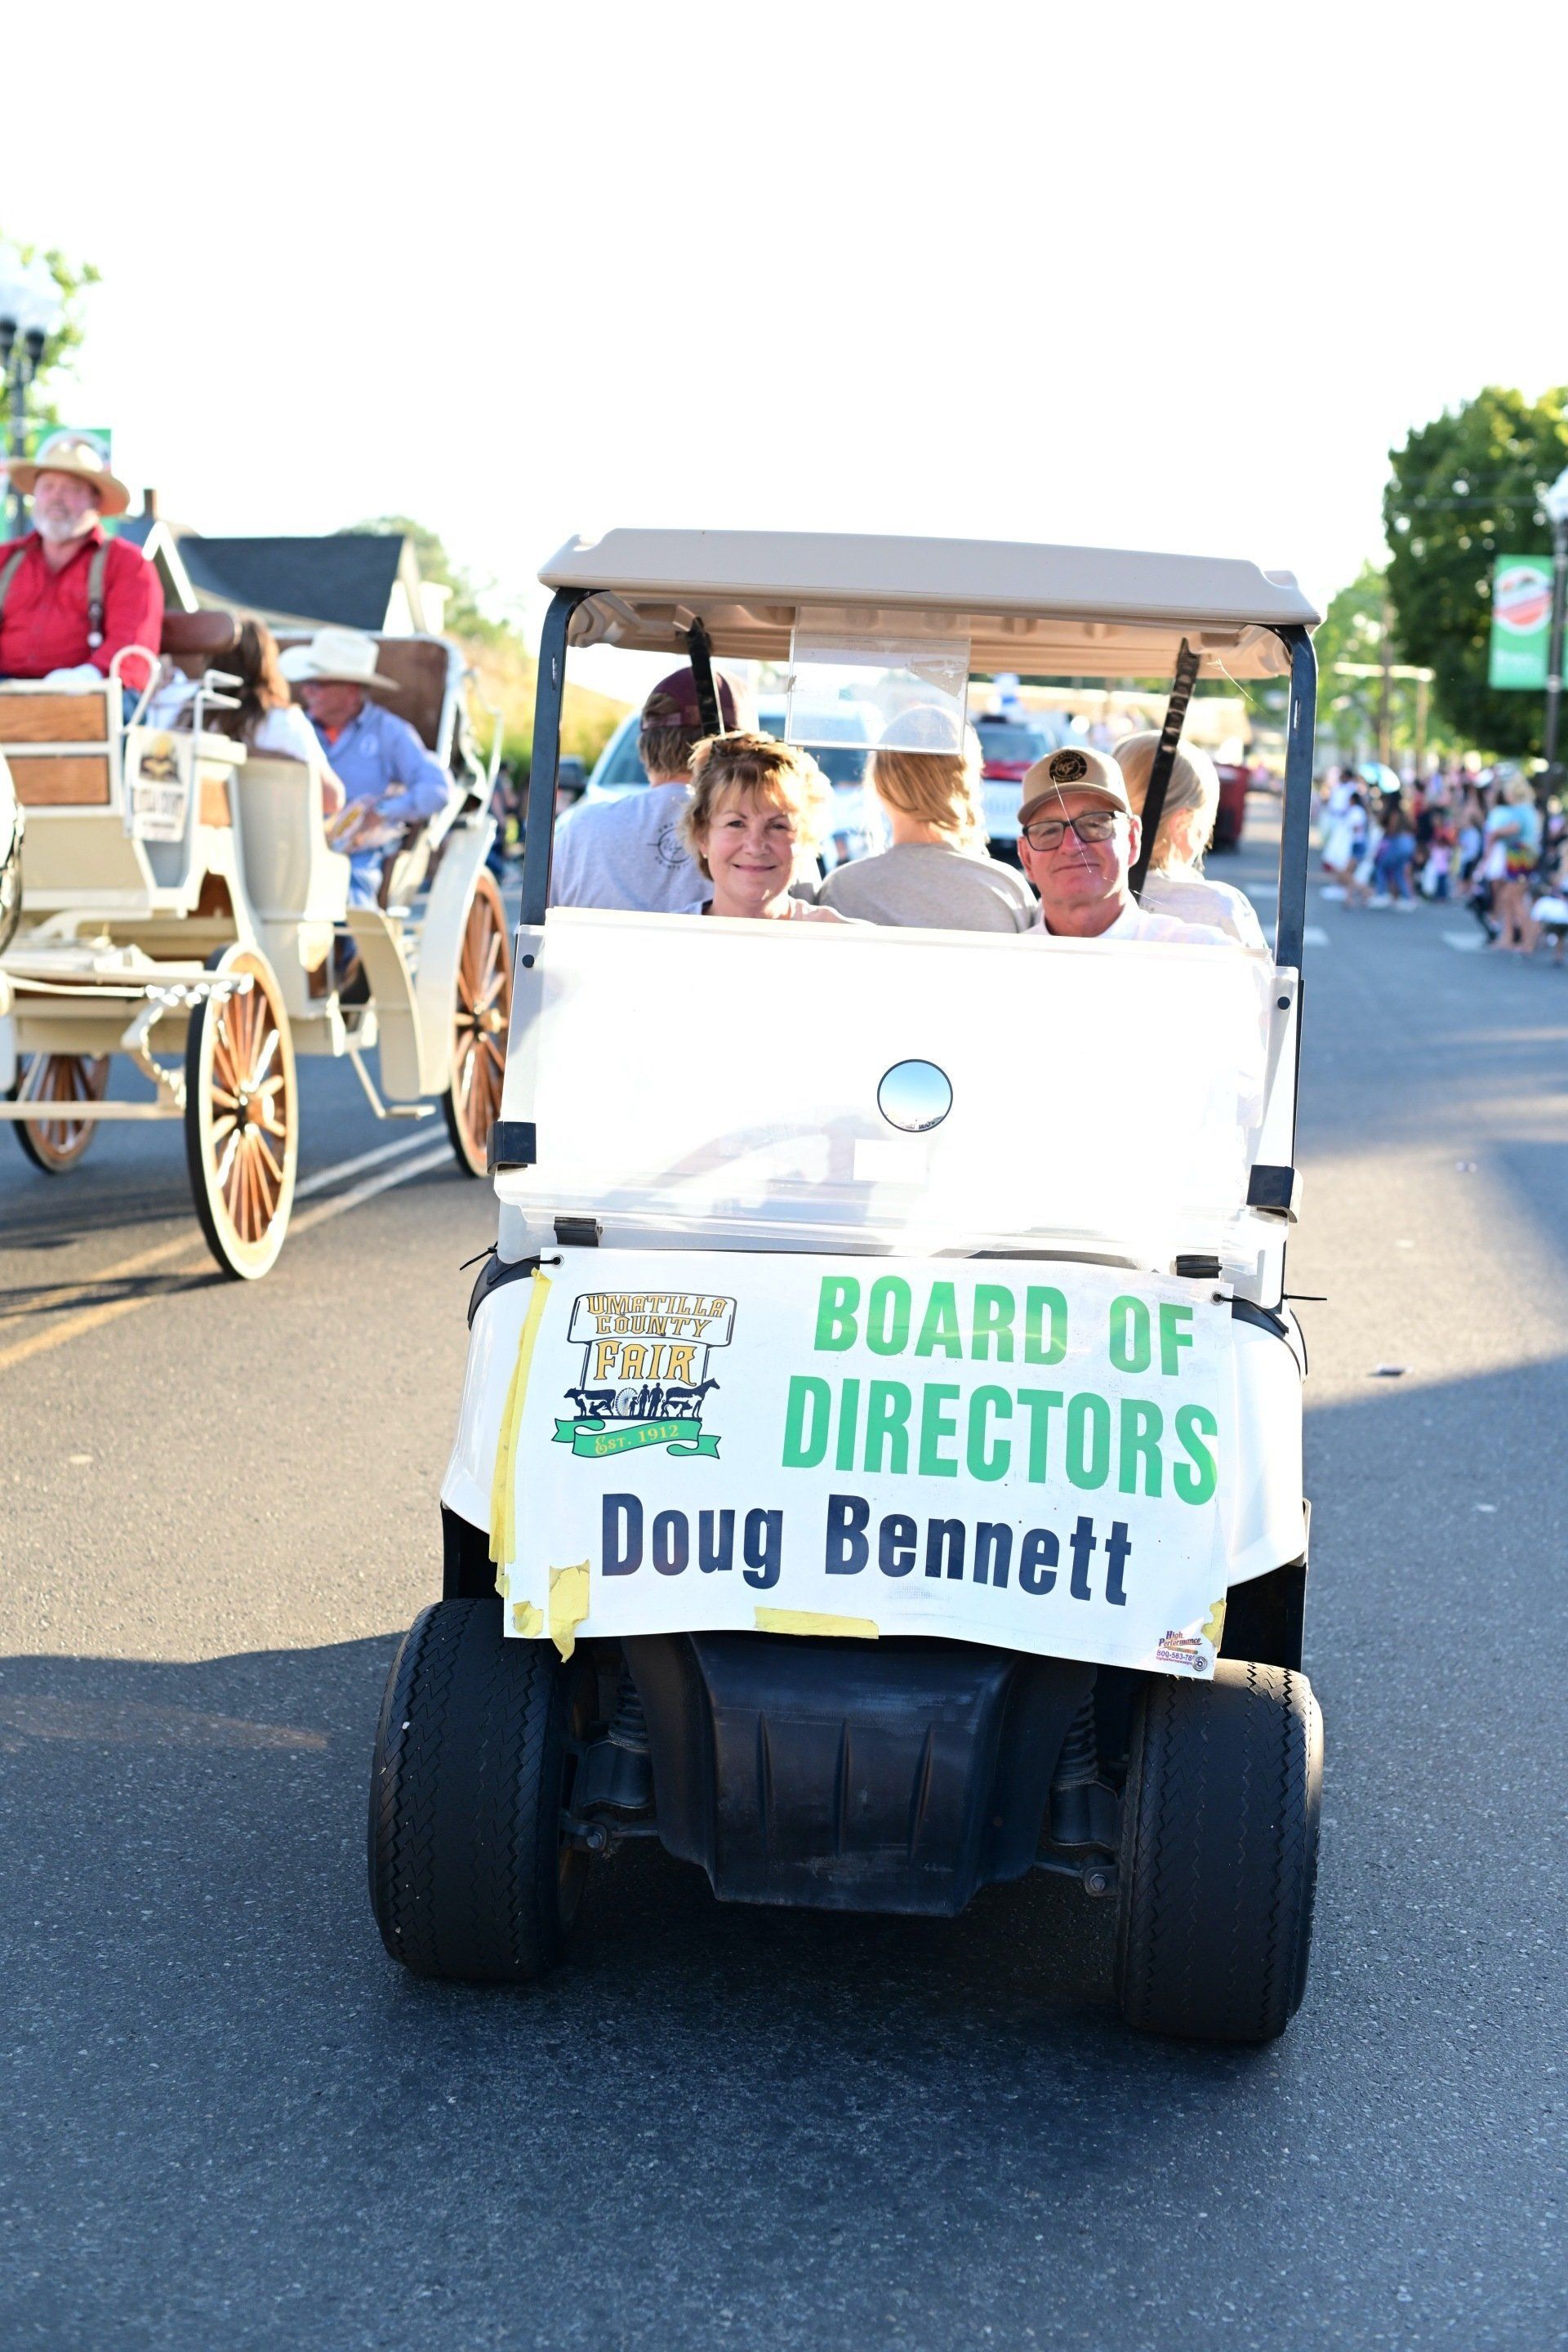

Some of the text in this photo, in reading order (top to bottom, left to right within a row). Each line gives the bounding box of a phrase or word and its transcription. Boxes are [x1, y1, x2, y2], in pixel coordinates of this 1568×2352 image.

[586, 1294, 728, 1318] UMATILLA
[595, 1315, 712, 1338] COUNTY
[813, 1276, 1194, 1377] BOARD OF
[594, 1340, 697, 1387] FAIR
[638, 1424, 679, 1444] 1912
[781, 1374, 1218, 1506] DIRECTORS
[601, 1493, 1133, 1606] Doug Bennett
[1158, 1637, 1202, 1647] Performance
[1165, 1630, 1183, 1640] High
